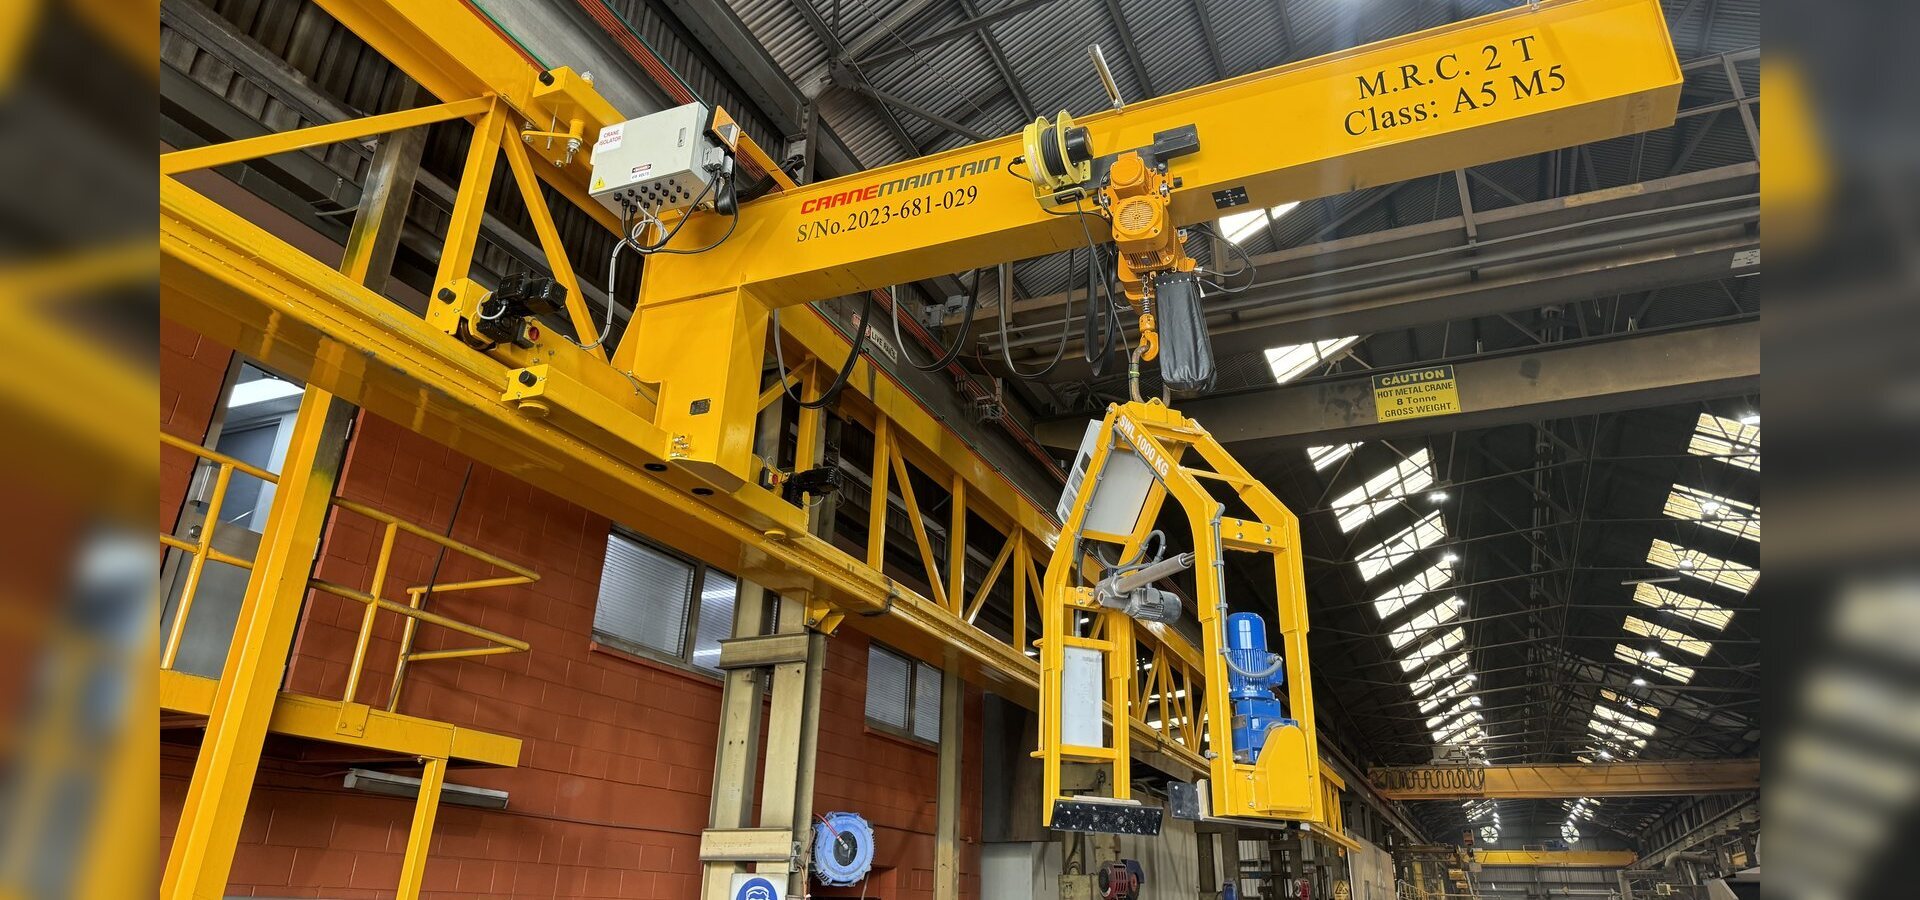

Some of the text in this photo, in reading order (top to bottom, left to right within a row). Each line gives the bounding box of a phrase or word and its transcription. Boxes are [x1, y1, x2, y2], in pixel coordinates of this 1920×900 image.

[1355, 35, 1535, 100] M.R.C. 2 T
[1344, 64, 1565, 136] Class: A5 M5
[599, 135, 622, 146] ISOLATOR
[603, 129, 620, 139] CRANE
[1381, 369, 1445, 386] CAUTION
[1377, 381, 1454, 399] HOT METAL CRANE
[1406, 395, 1437, 404] Tonne
[1384, 402, 1451, 418] GROSS WEIGHT
[1119, 415, 1169, 477] SWL 1000 KG
